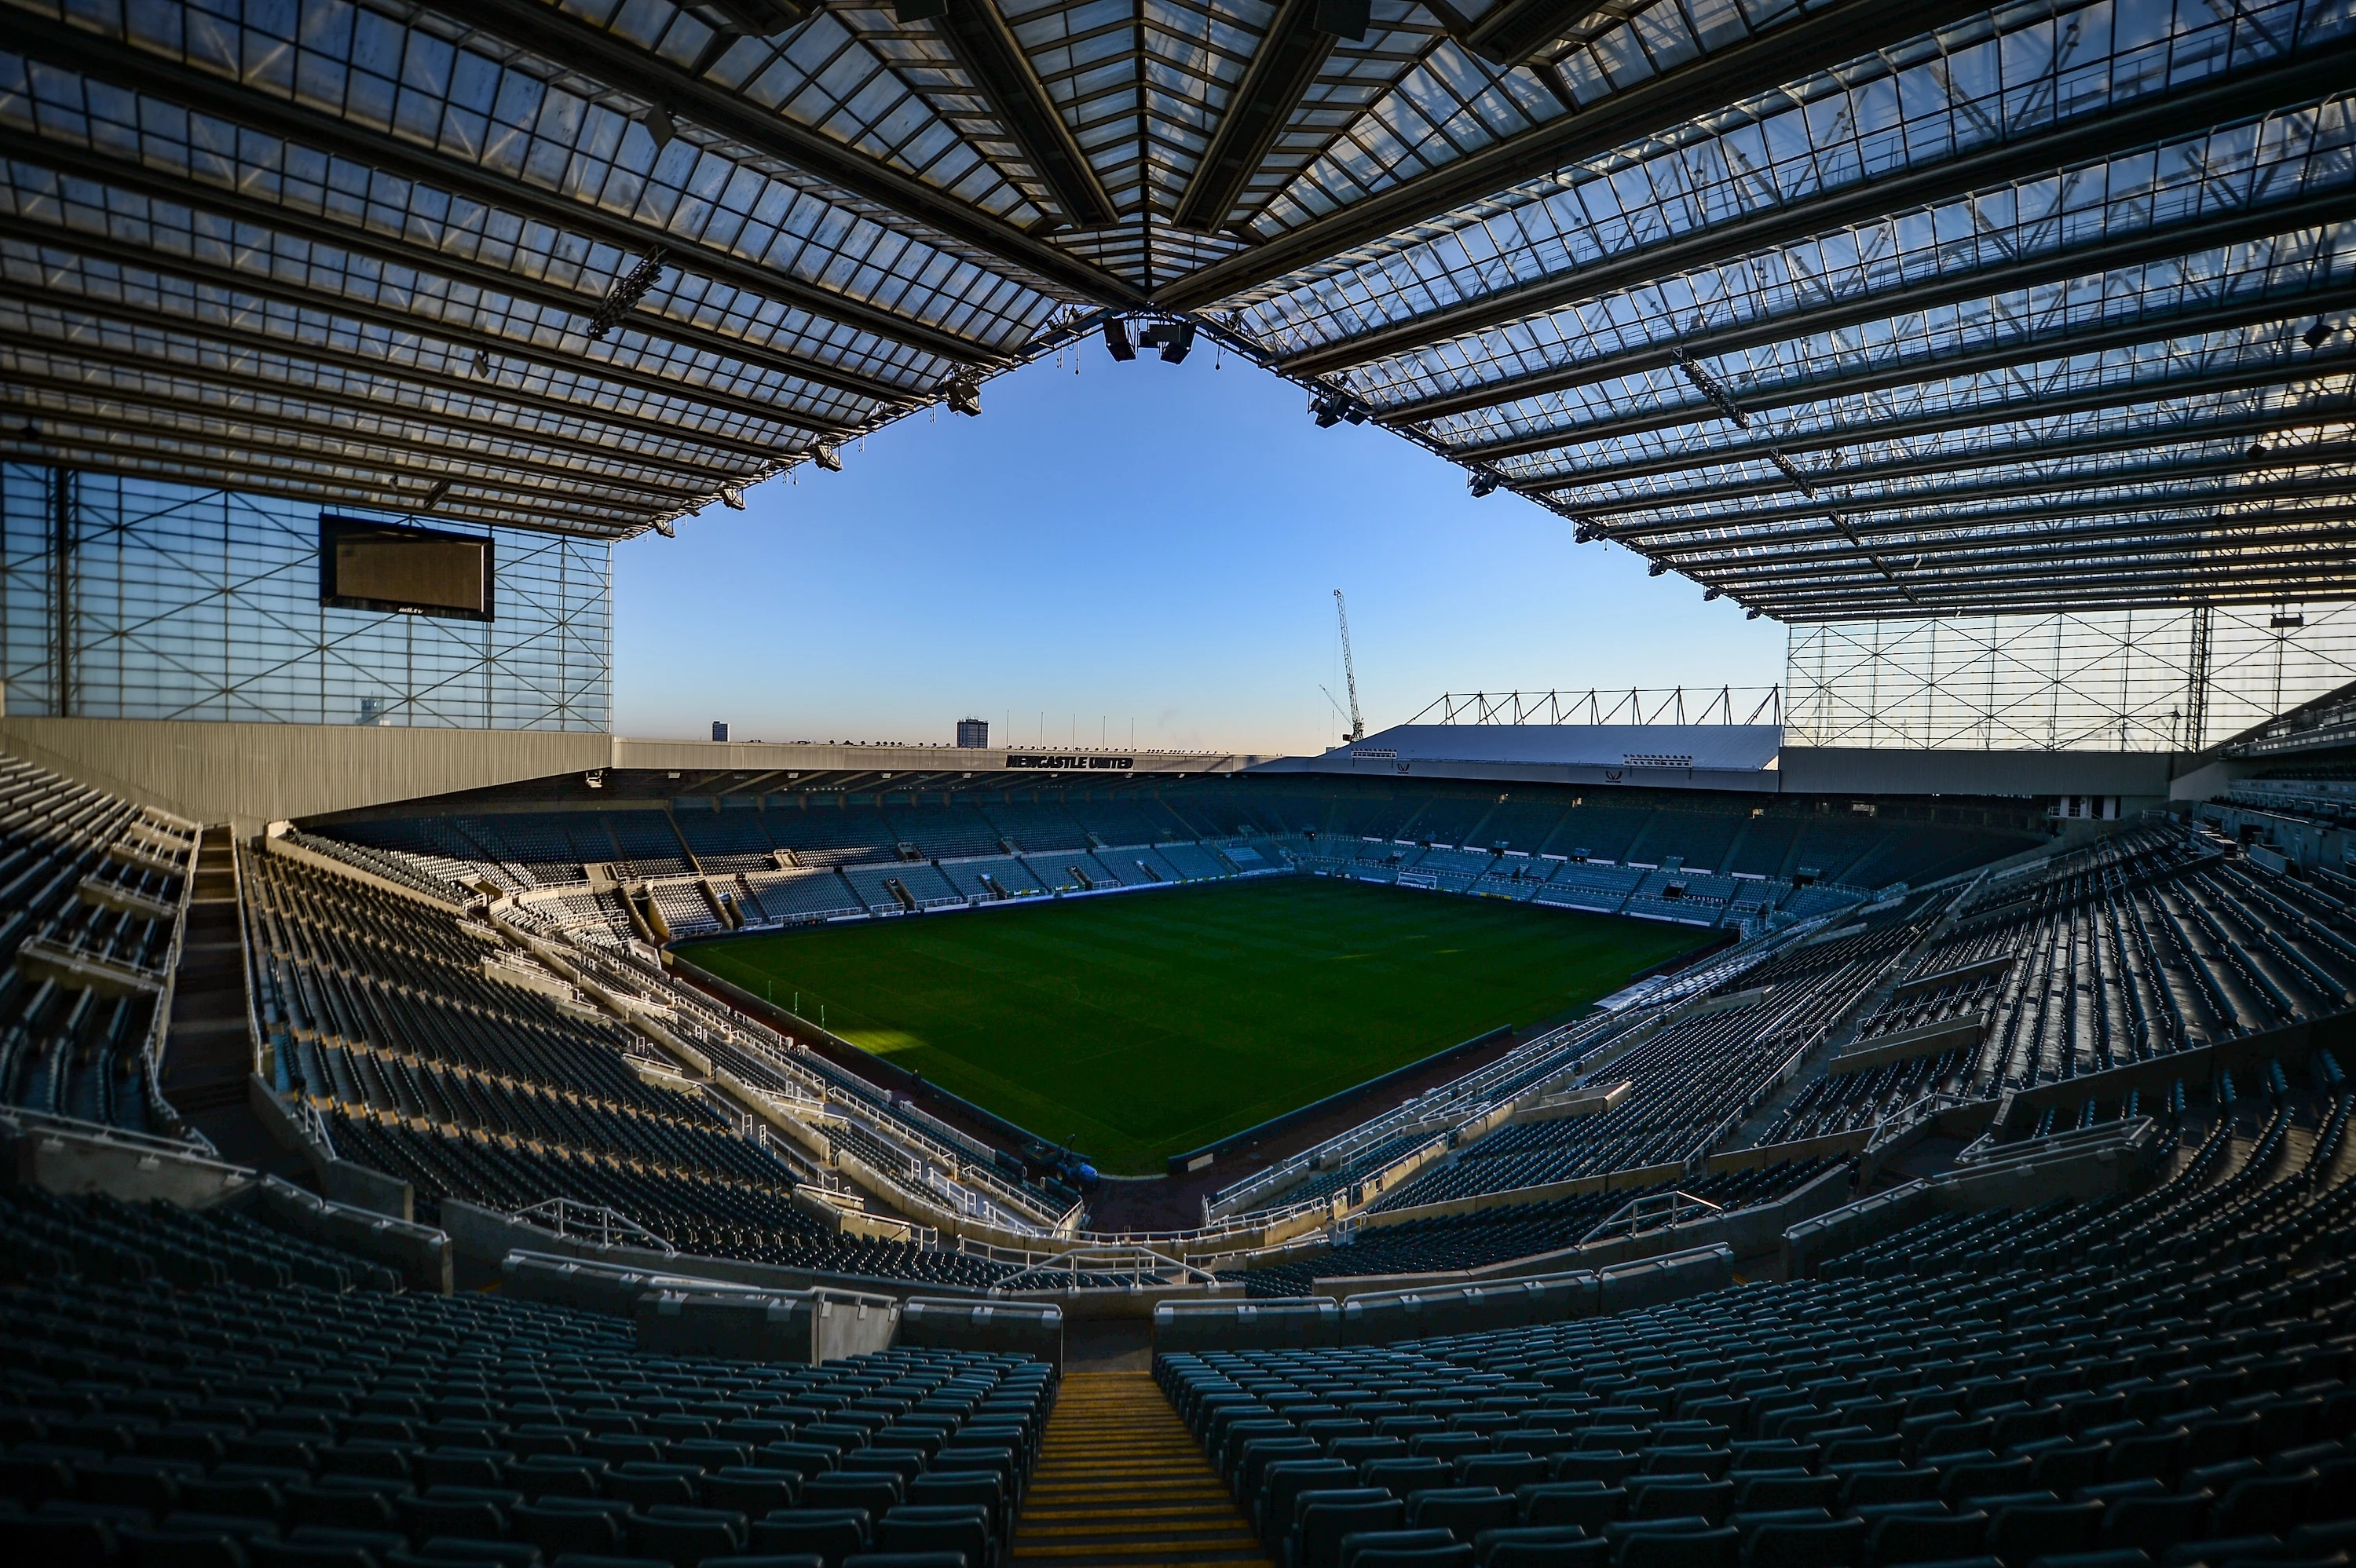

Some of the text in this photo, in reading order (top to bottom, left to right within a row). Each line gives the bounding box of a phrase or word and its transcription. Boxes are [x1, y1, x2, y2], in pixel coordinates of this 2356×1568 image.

[1006, 755, 1133, 769] NEWCASTLE UNITED
[1692, 895, 1724, 904] CASTORE
